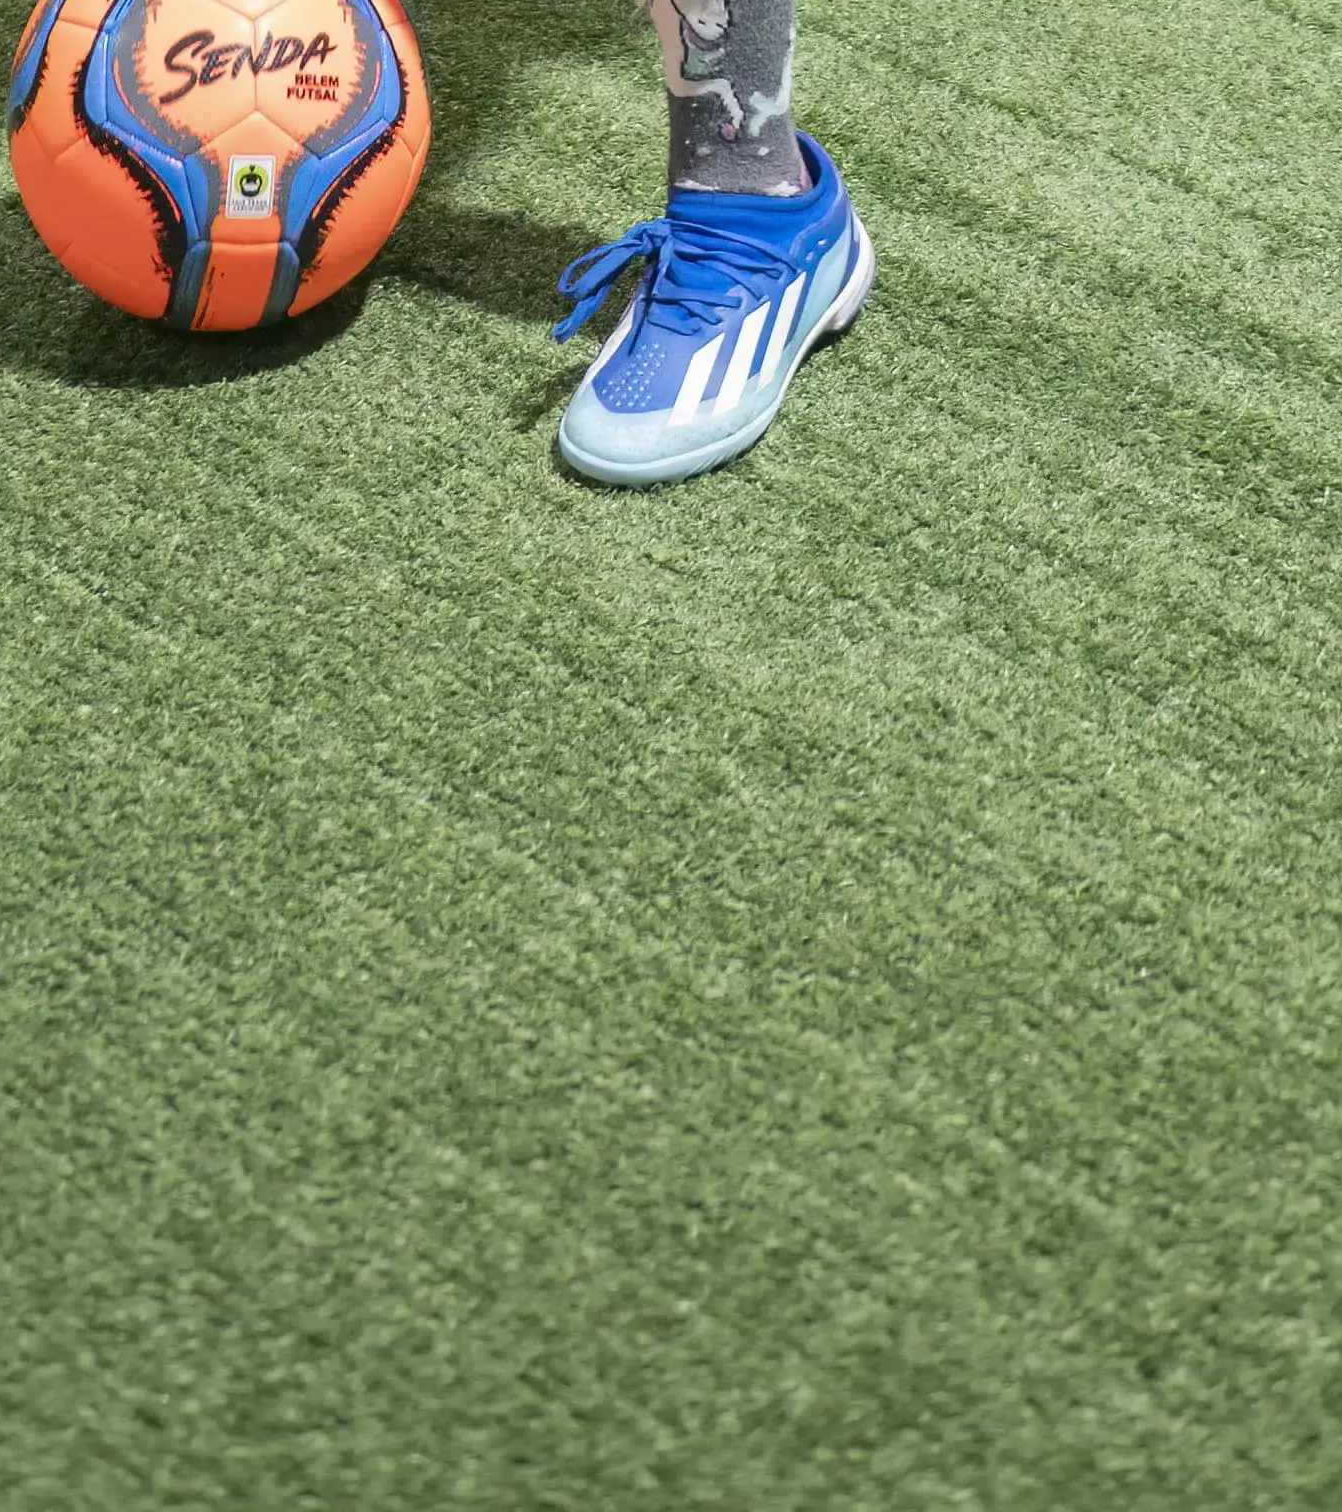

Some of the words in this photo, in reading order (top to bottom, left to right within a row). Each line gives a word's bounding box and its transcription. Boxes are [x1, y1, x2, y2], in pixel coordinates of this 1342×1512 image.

[159, 29, 338, 105] SENDA
[294, 73, 340, 88] BELEM
[286, 86, 339, 102] FUTSAL
